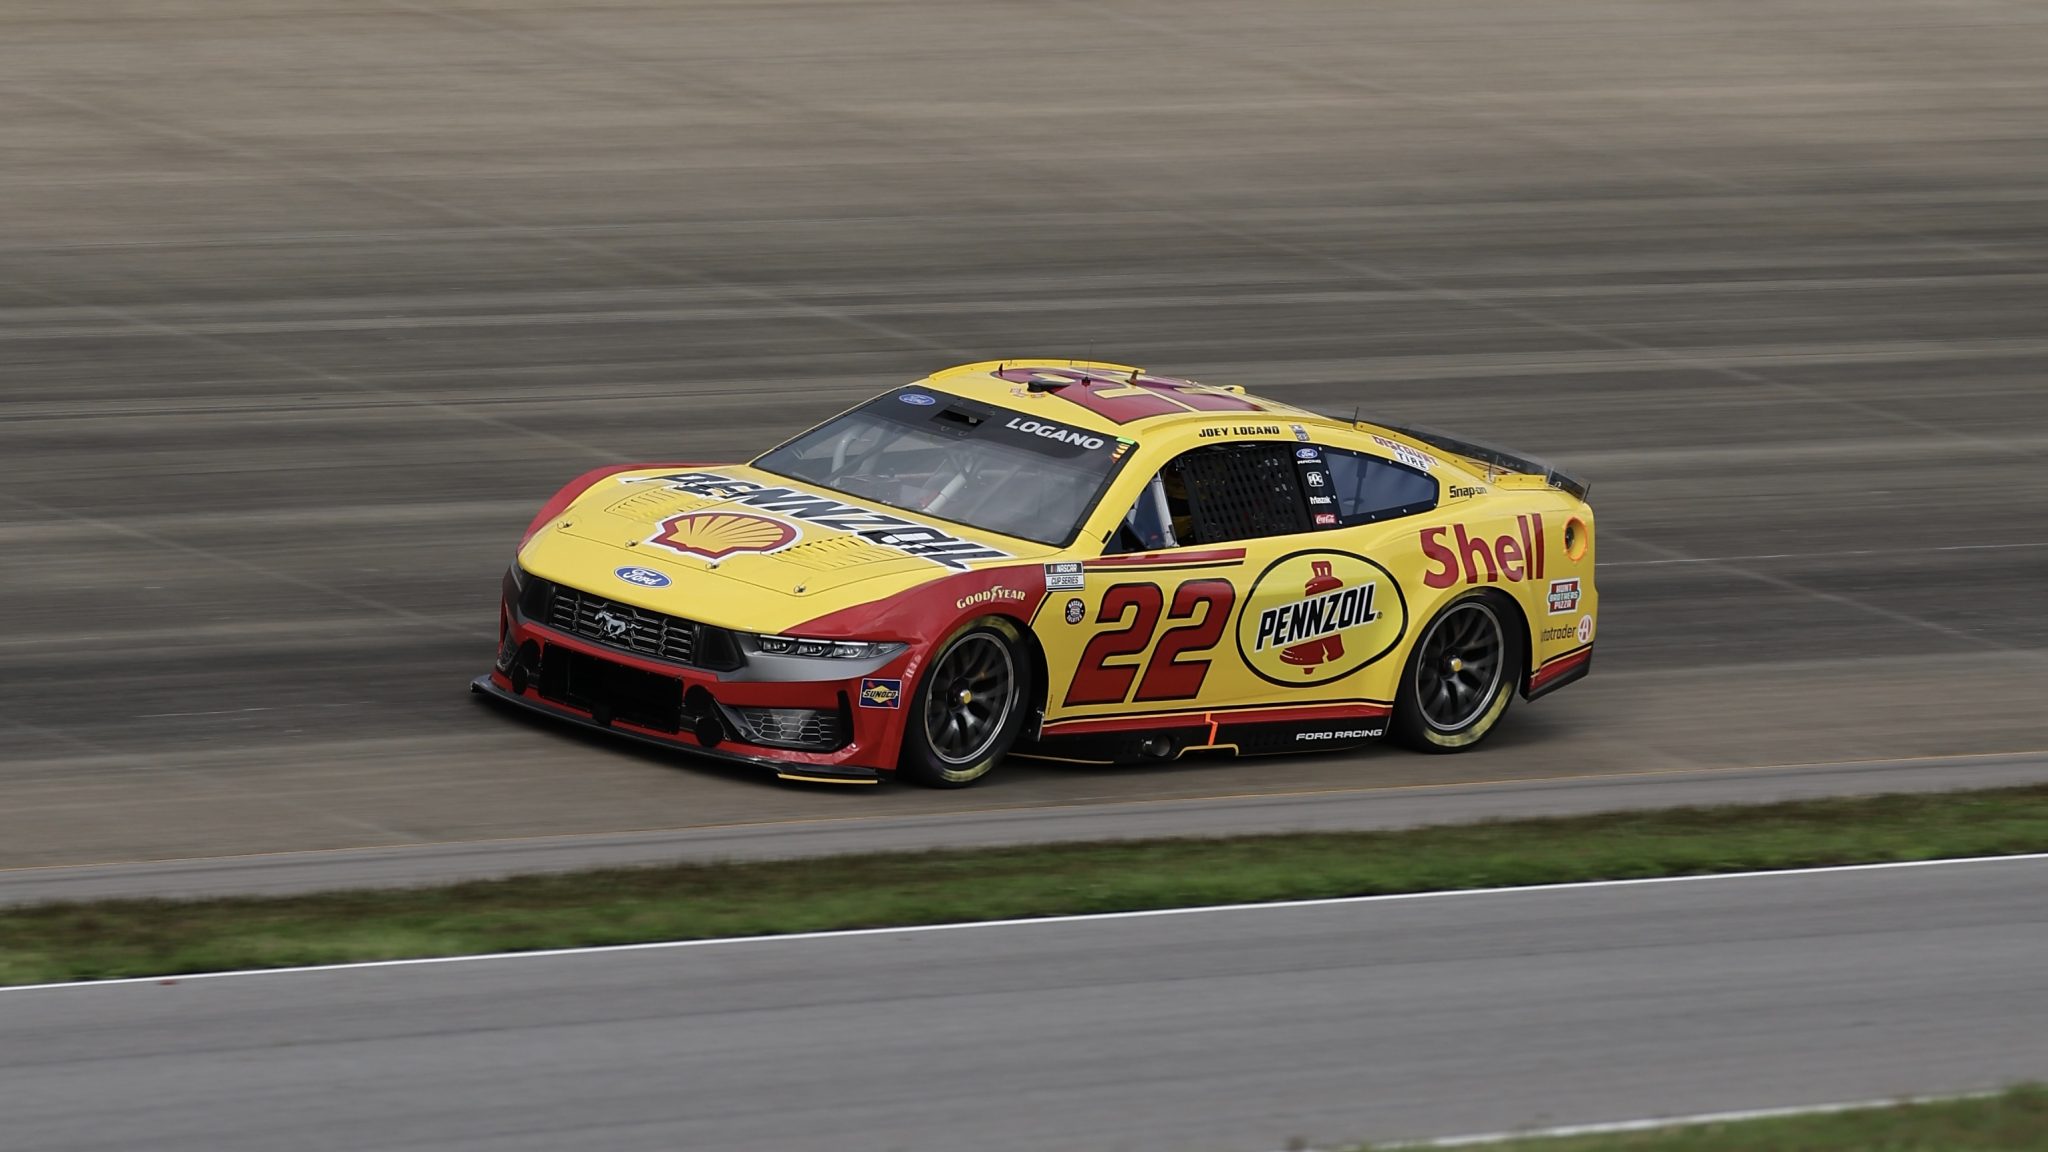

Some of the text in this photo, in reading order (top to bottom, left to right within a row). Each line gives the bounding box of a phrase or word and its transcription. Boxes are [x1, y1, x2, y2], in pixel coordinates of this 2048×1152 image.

[1005, 417, 1104, 450] LOGANO
[1199, 426, 1229, 438] JOEY
[1233, 425, 1280, 436] LOGANO
[1372, 435, 1438, 466] DISCOUNT
[1396, 452, 1427, 469] TIRE
[1449, 485, 1487, 498] Snap-on
[617, 472, 1015, 573] PENNZOIL
[1420, 513, 1545, 589] Shell
[1056, 563, 1078, 573] NASCAR
[1051, 576, 1079, 585] CUP SERIES
[956, 586, 1026, 609] GOODYEAR
[1254, 582, 1378, 652] PENNZOIL
[1062, 578, 1236, 707] 22
[864, 690, 897, 698] SUNOCO
[1296, 729, 1383, 740] FORD RACING
